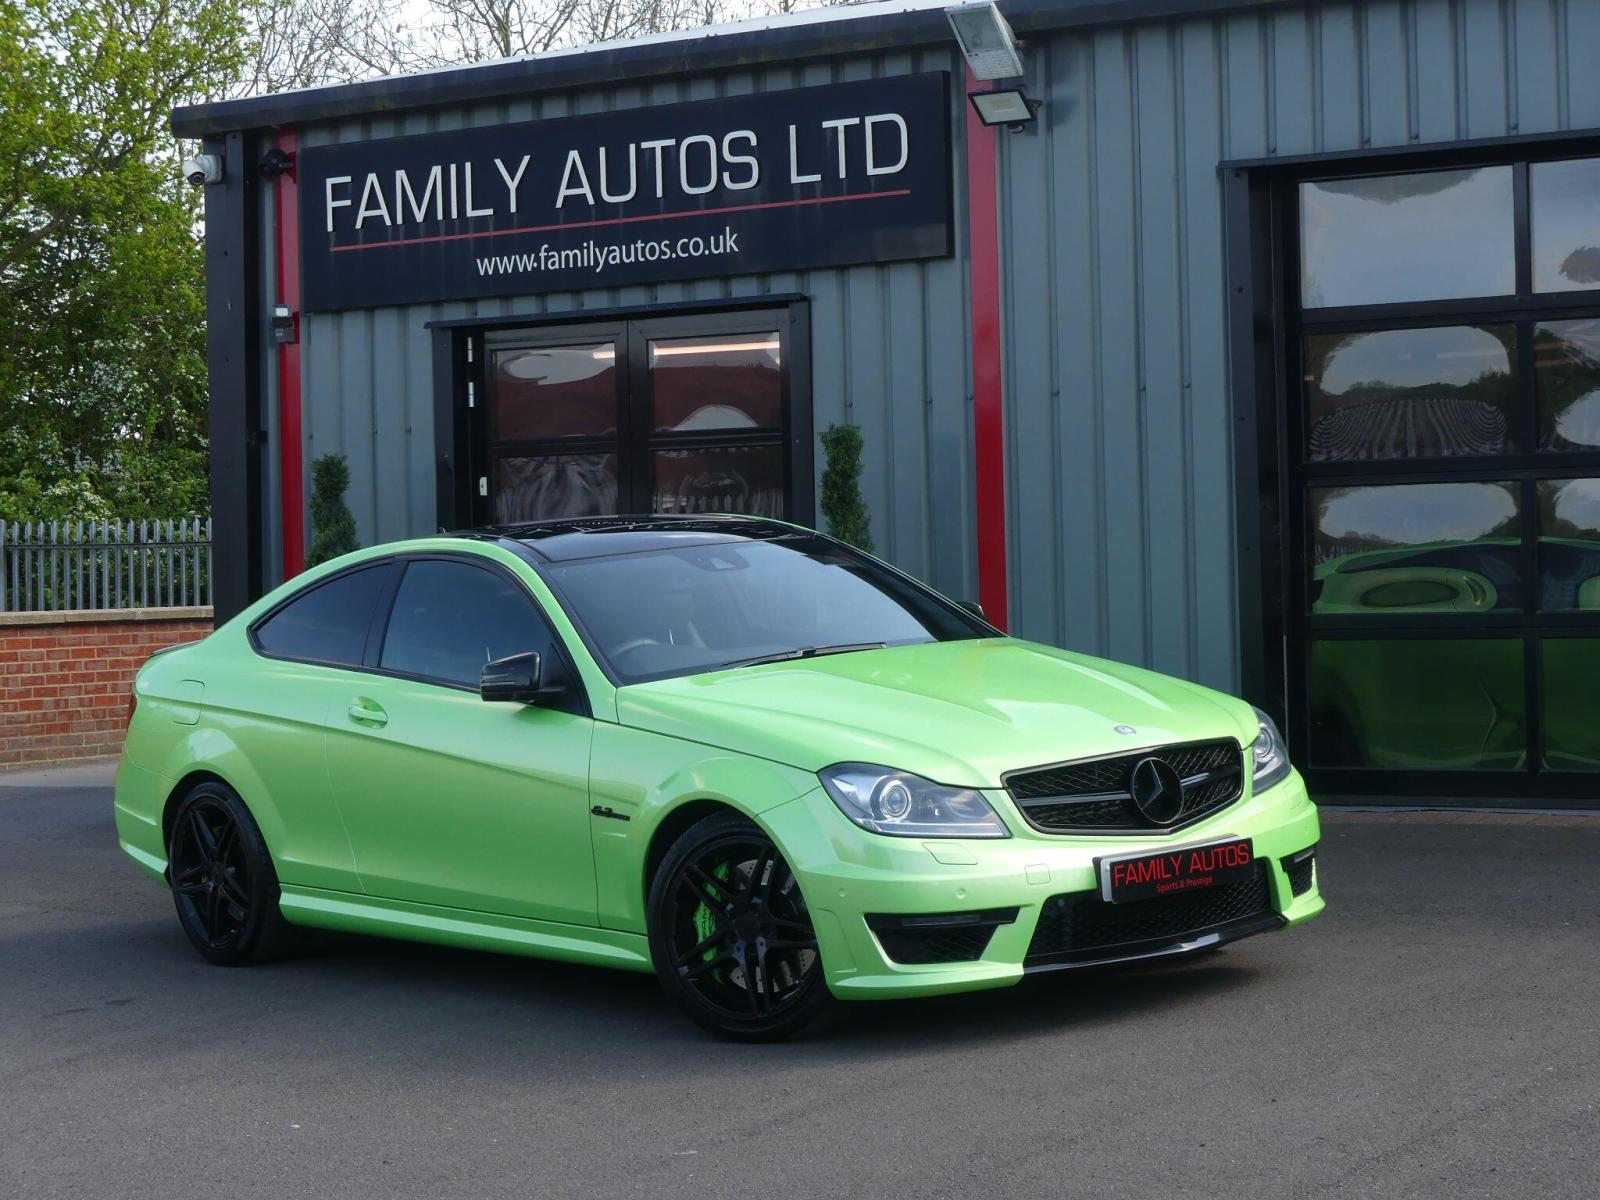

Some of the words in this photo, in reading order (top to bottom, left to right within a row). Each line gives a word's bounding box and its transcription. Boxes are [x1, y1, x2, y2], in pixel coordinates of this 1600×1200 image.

[325, 154, 531, 232] FAMILY
[555, 130, 759, 208] AUTOS
[788, 112, 910, 185] LTD
[476, 226, 739, 276] www.familyautos.co.uk
[1114, 855, 1183, 887] FAMILY
[1189, 844, 1249, 873] AUTOS
[1156, 881, 1178, 893] Sports
